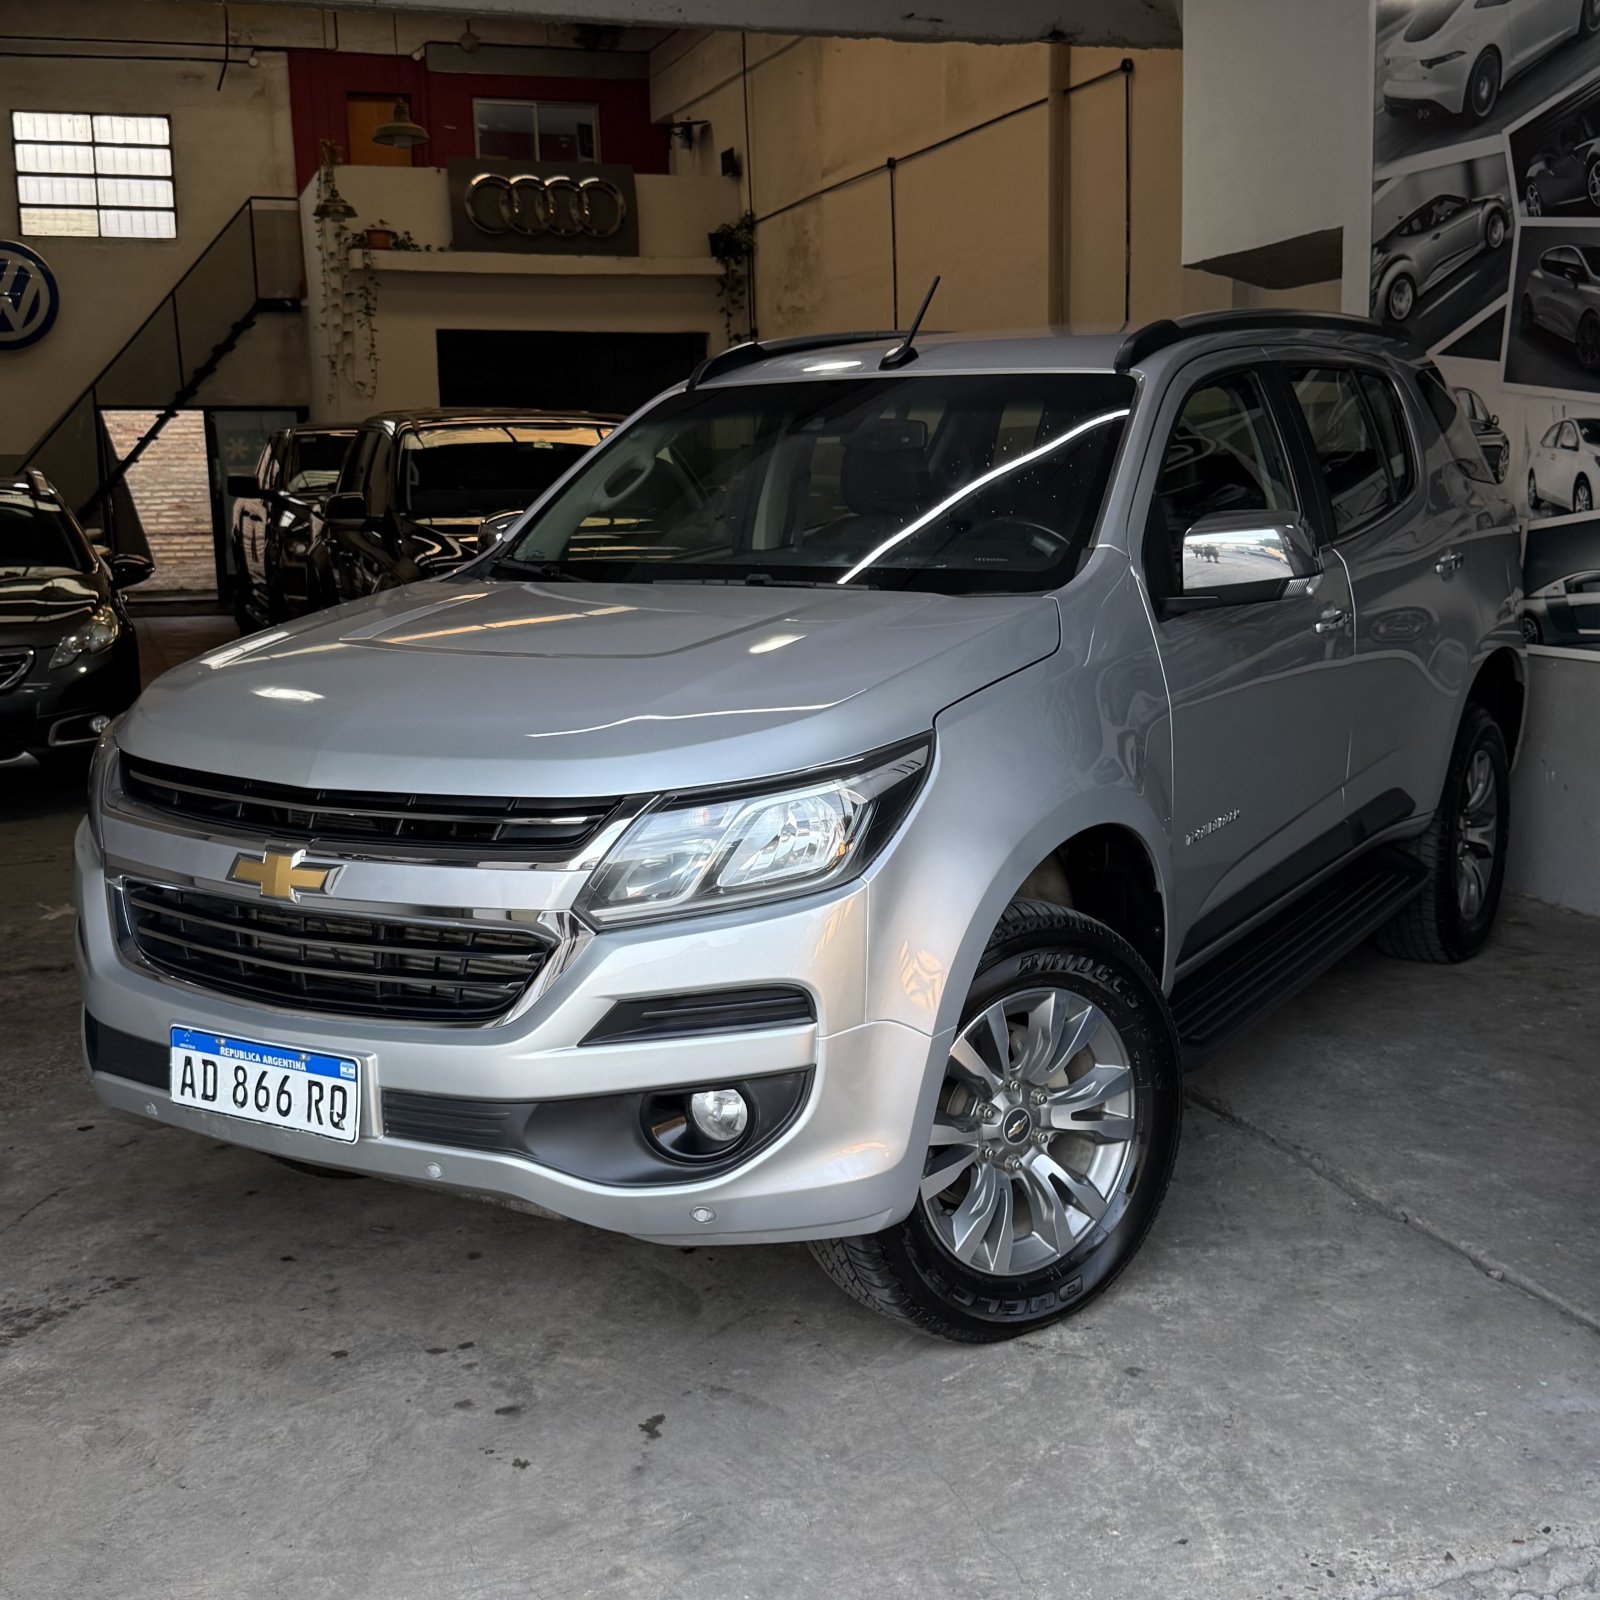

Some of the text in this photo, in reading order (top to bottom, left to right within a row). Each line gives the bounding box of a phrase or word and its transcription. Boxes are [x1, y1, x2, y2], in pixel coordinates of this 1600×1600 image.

[219, 1046, 307, 1072] REPUBLICA ARGENTINA
[180, 1055, 348, 1131] AD 866 RQ
